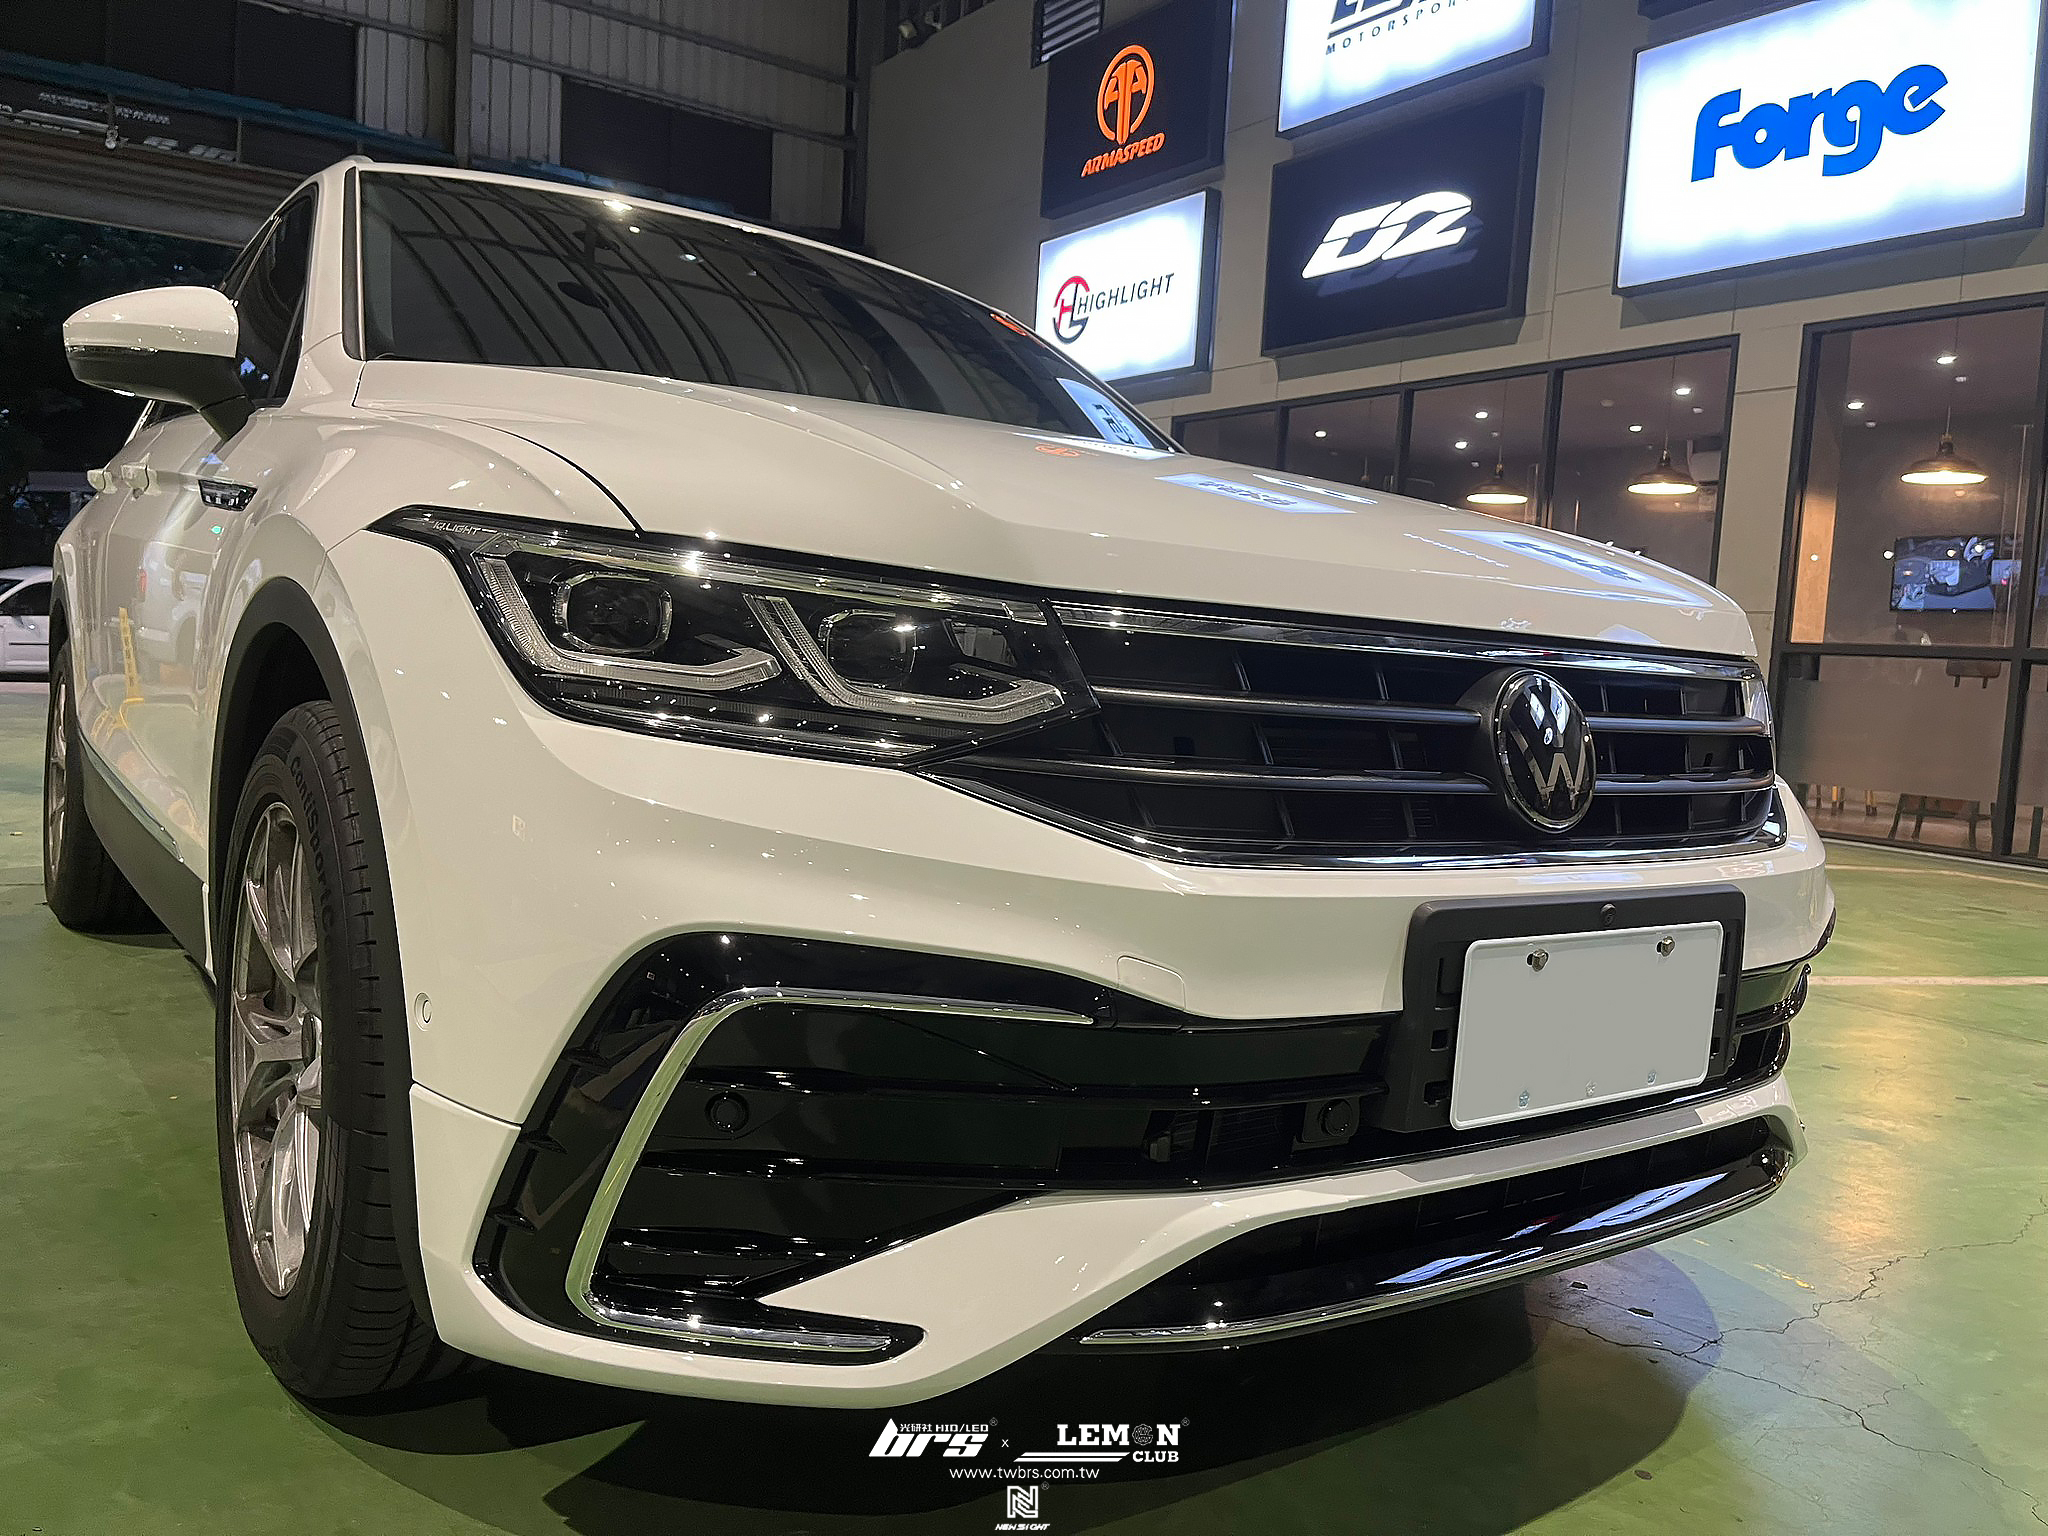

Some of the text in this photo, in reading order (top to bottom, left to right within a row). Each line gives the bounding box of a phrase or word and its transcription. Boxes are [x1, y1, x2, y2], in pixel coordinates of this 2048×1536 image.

[1326, 0, 1469, 55] MOTORSPOR
[1081, 132, 1166, 178] ARMASPEED
[1301, 191, 1473, 279] D2
[1077, 273, 1175, 315] HIGHLIGHT
